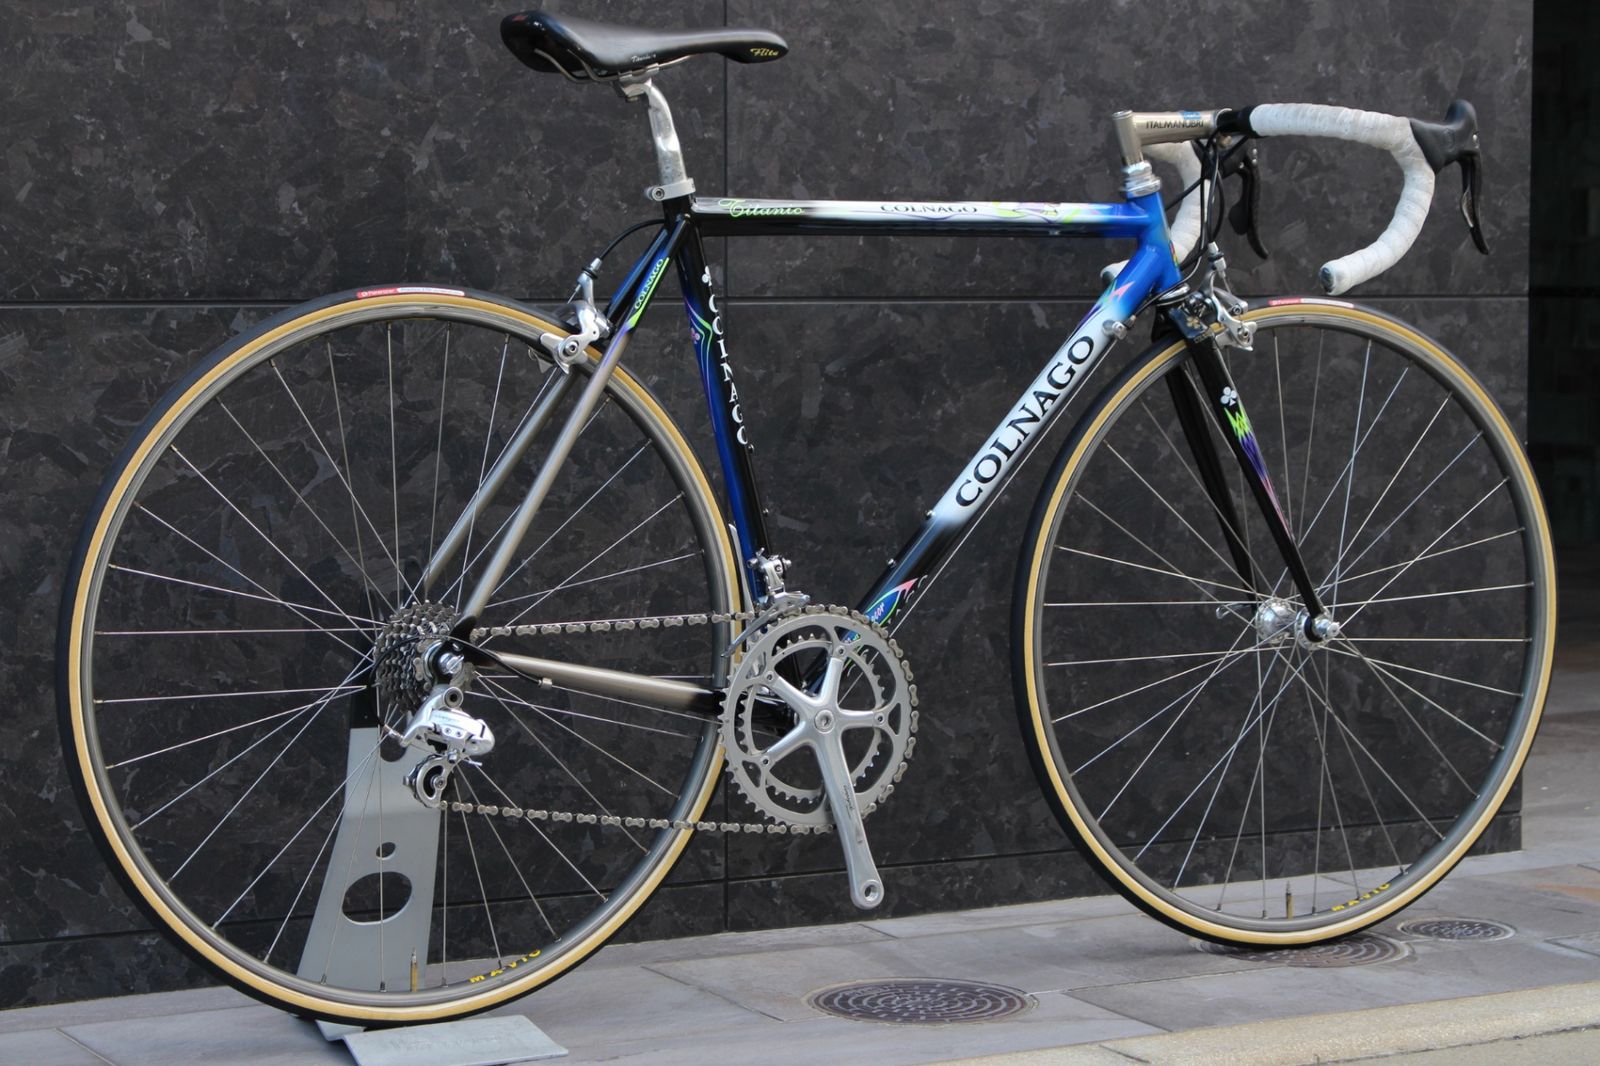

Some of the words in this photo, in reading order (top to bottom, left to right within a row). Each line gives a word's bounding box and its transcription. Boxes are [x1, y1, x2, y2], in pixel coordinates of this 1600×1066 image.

[1146, 119, 1204, 130] ITALMANUBRI
[879, 203, 978, 213] COLNAGO
[634, 258, 664, 310] COLNAGO
[955, 335, 1095, 508] COLNAGO
